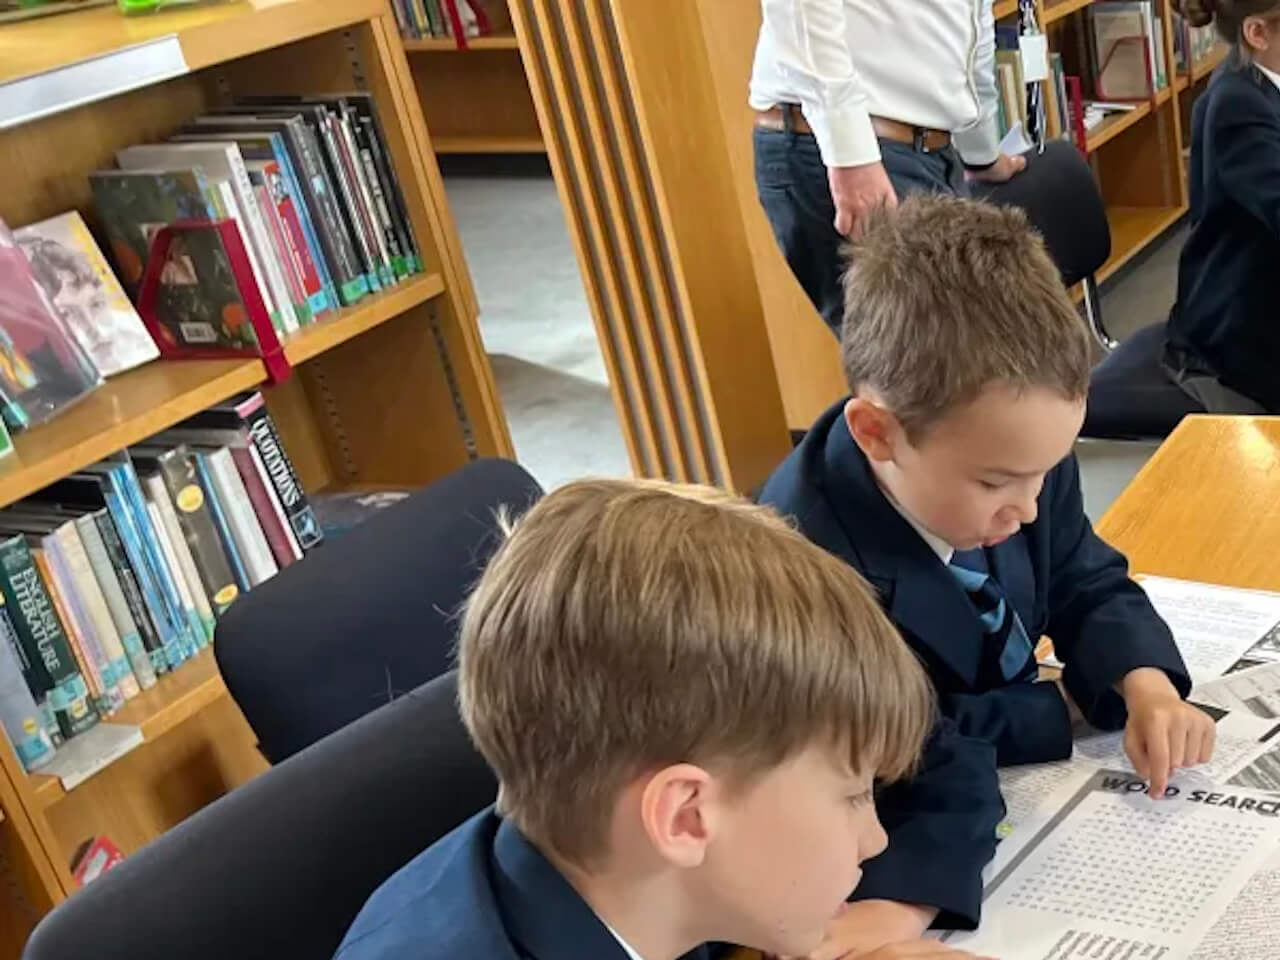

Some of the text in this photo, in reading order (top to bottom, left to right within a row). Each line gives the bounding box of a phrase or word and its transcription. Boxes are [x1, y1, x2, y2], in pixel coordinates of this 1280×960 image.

[250, 417, 301, 507] QUOTATIONS
[10, 572, 61, 673] LITERATURE
[24, 566, 60, 639] ENGLISH
[1101, 776, 1180, 798] WOD
